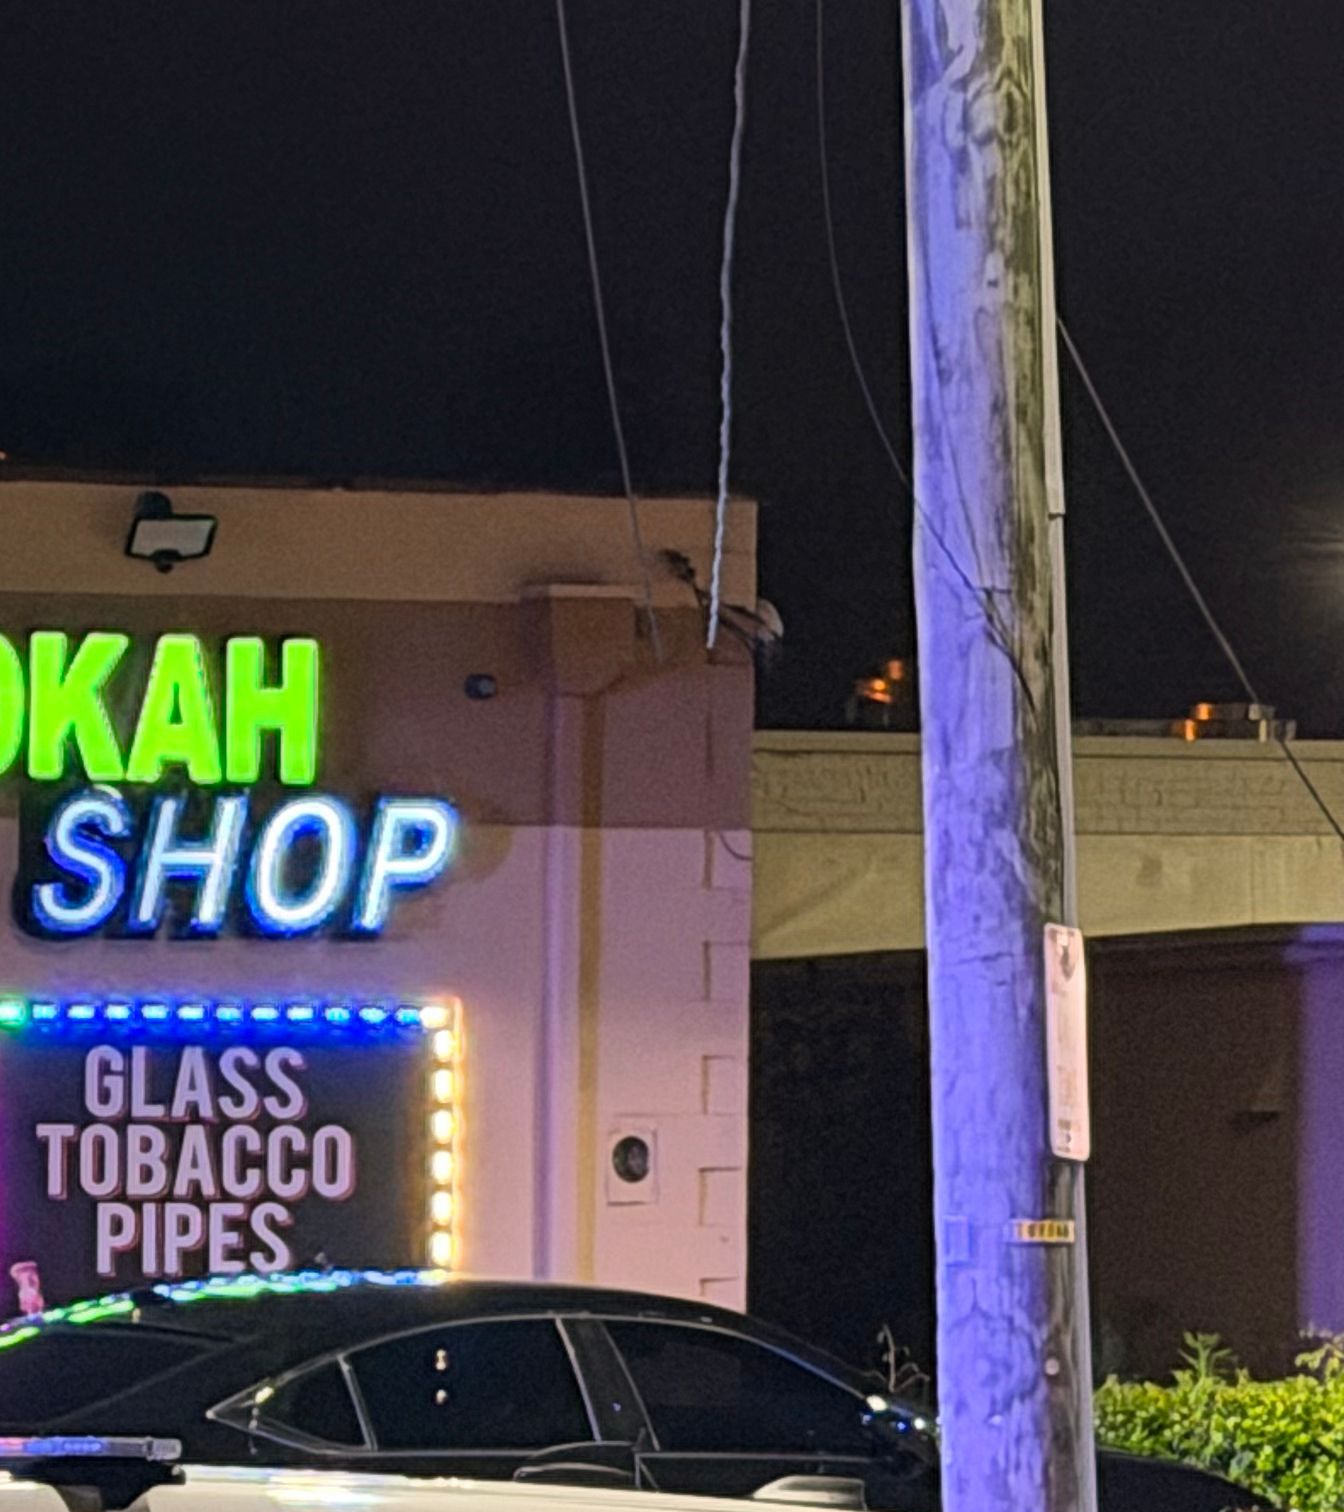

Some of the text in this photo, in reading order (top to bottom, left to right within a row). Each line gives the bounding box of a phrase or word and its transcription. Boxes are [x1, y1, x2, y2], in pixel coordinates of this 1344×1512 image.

[32, 786, 458, 938] SHOP
[84, 1045, 307, 1121] GLASS
[36, 1123, 356, 1201] TOBACCO
[96, 1201, 294, 1276] PIPES
